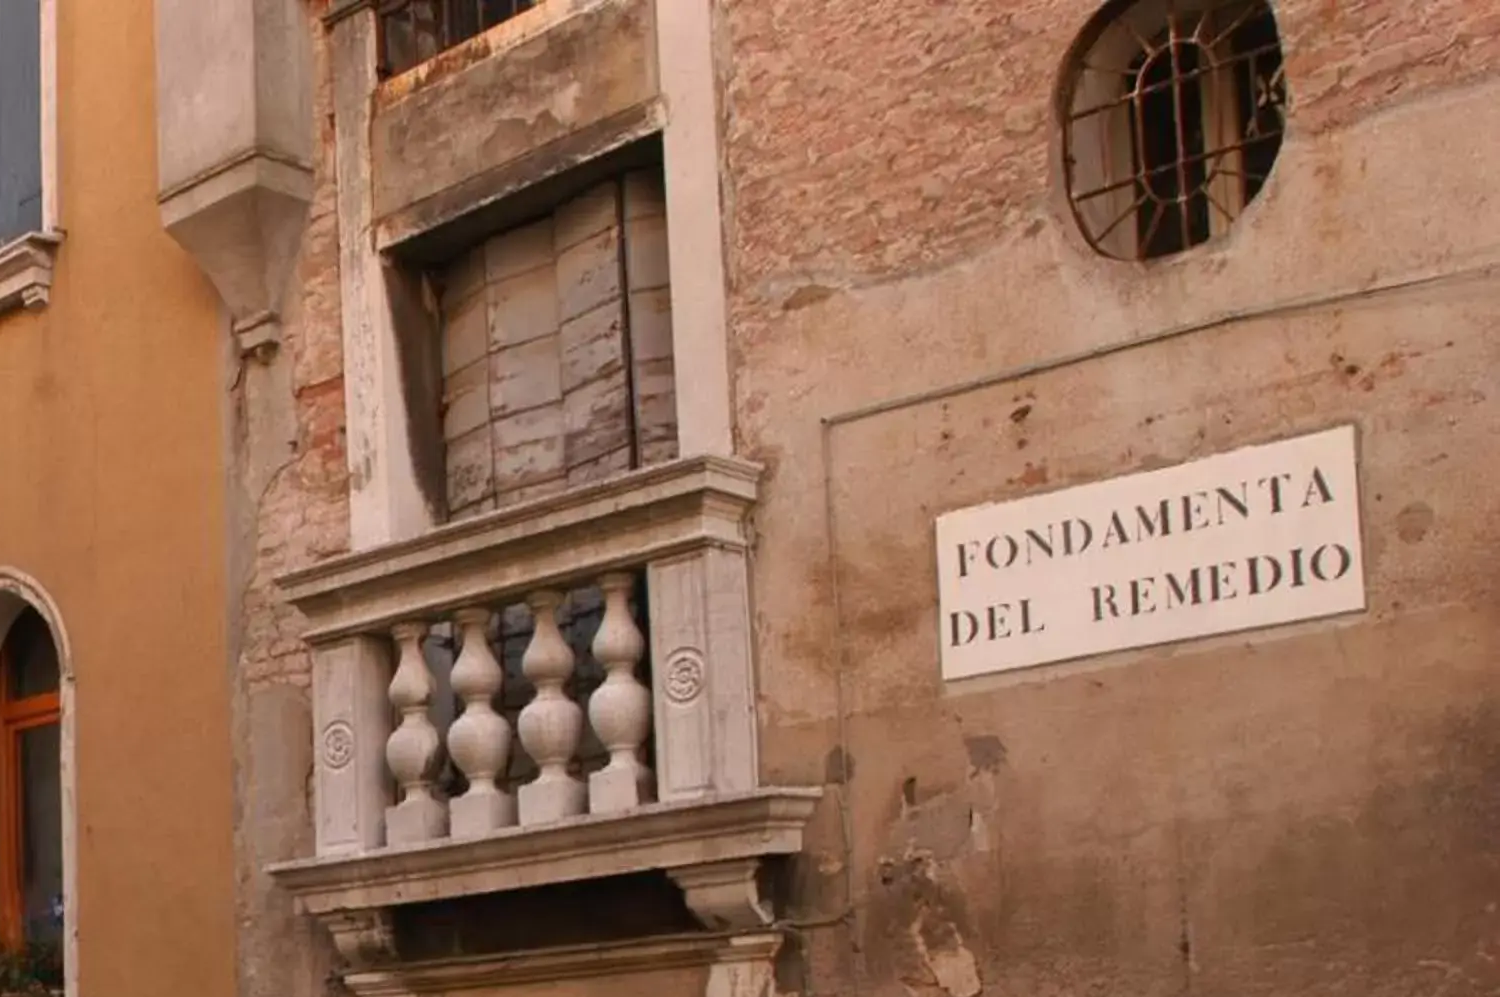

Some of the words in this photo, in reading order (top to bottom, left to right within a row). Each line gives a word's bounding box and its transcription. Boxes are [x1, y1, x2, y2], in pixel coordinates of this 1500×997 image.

[956, 465, 1335, 578] FONDAMENTA
[949, 598, 1046, 648] DEL
[1090, 542, 1352, 623] REMEDIO
